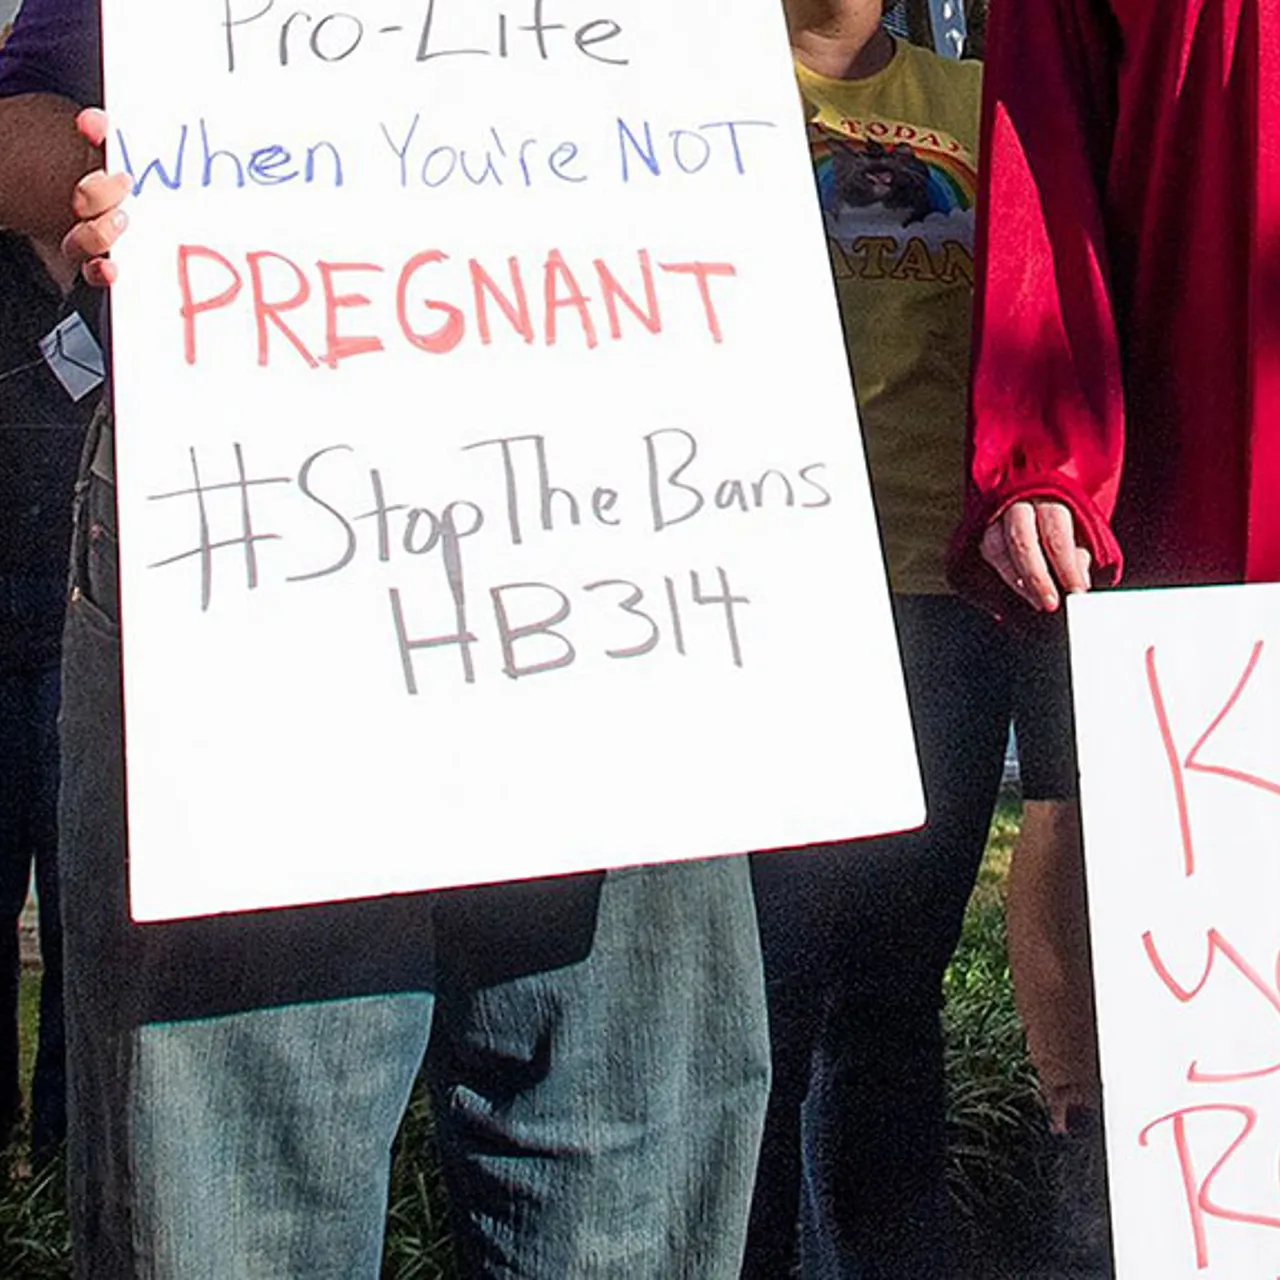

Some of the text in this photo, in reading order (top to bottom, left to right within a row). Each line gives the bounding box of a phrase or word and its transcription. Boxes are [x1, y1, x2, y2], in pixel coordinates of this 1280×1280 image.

[116, 114, 776, 197] When You're NOT
[177, 244, 737, 370] PREGNANT
[148, 428, 833, 612] #StopTheBans
[388, 567, 750, 695] HB314
